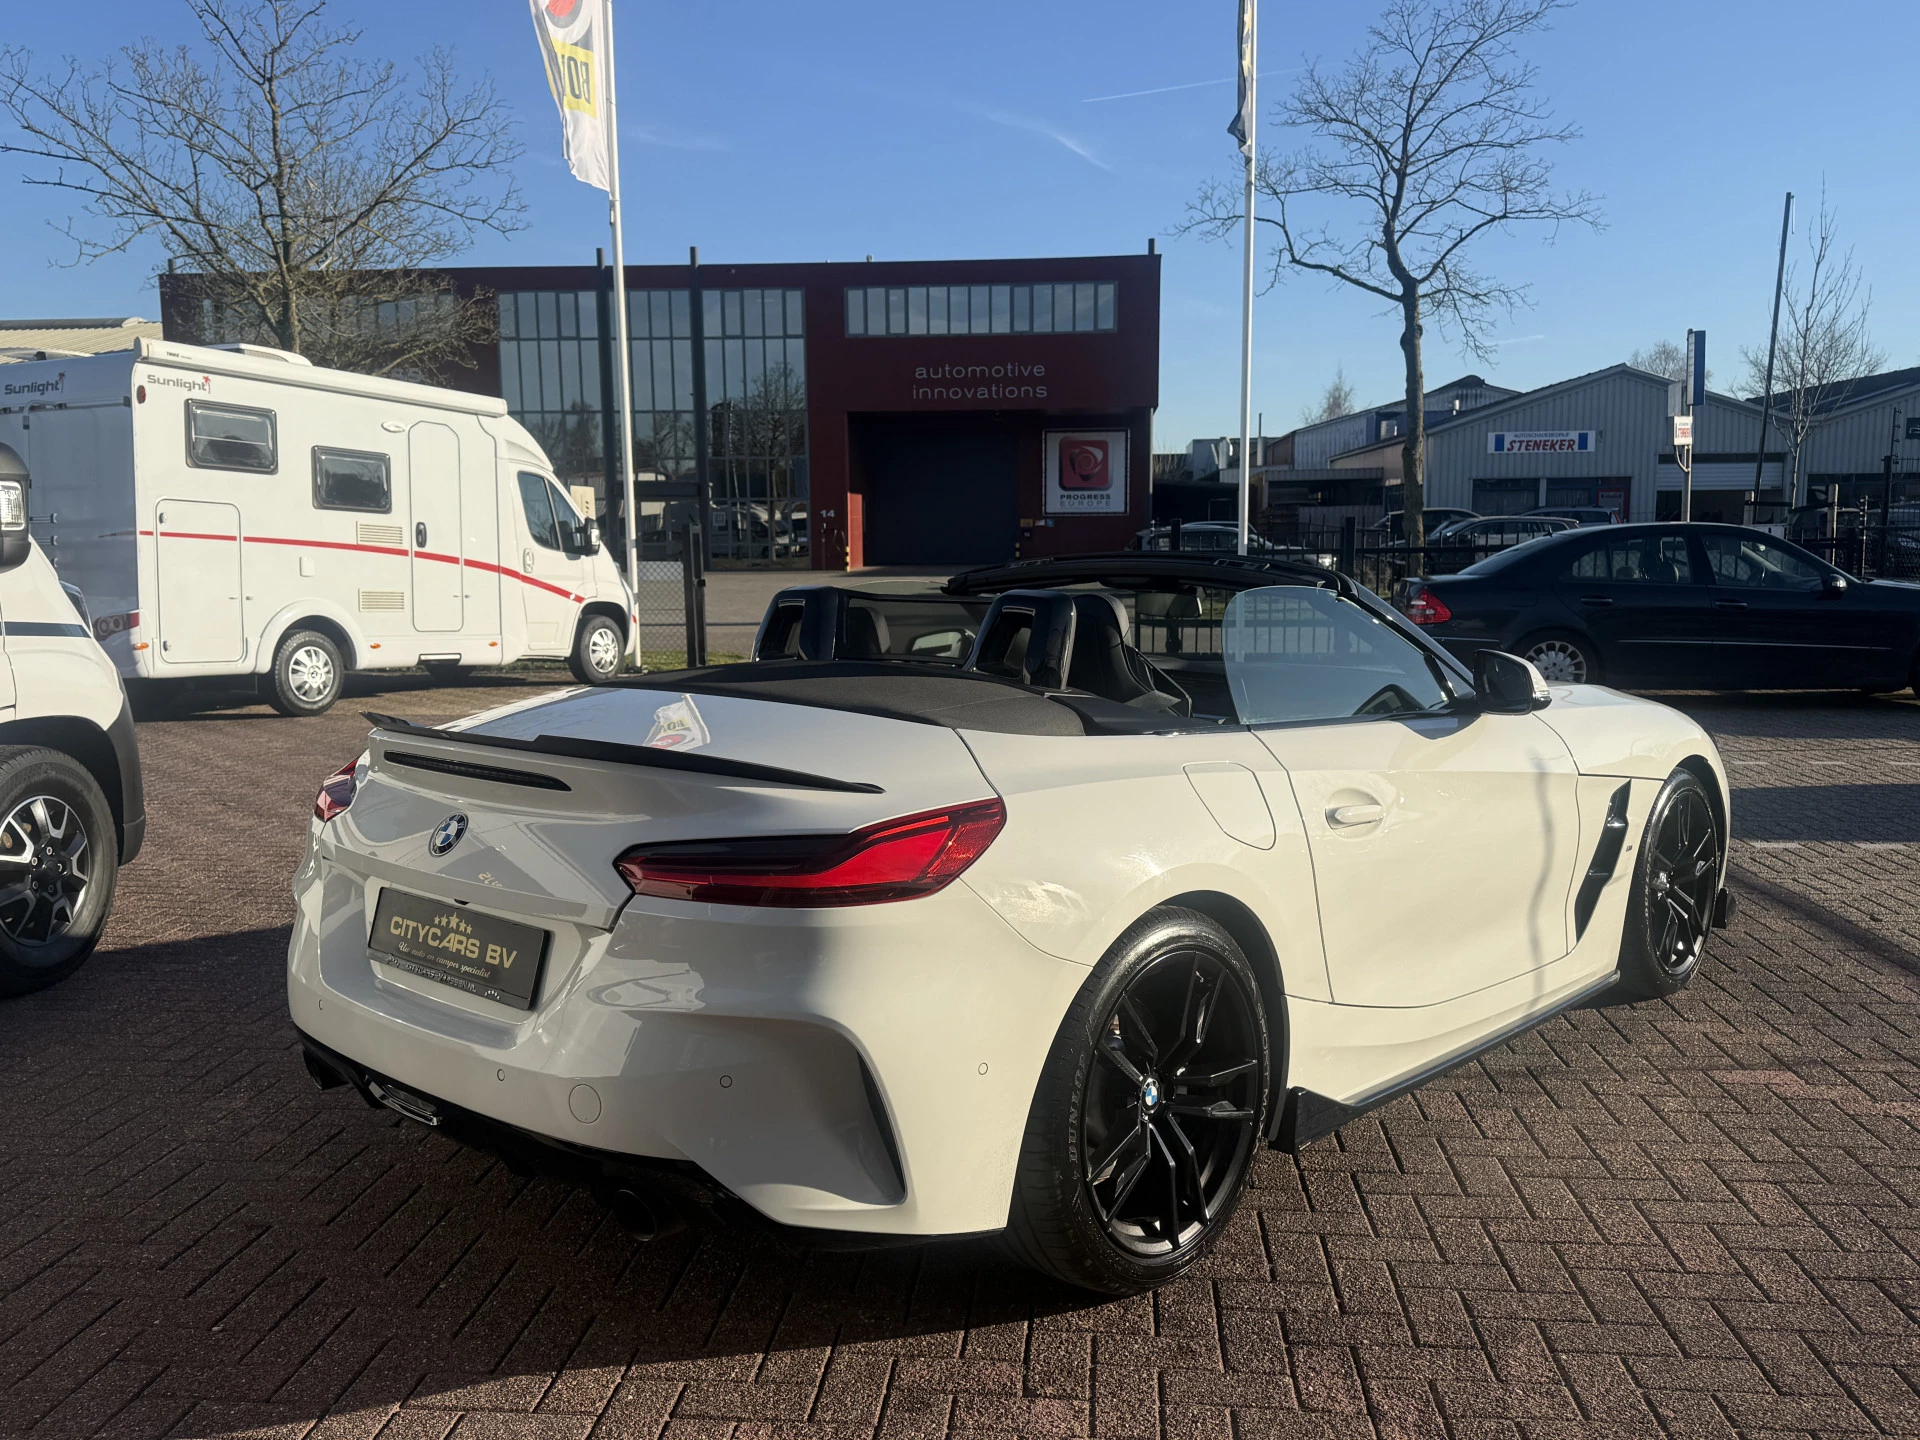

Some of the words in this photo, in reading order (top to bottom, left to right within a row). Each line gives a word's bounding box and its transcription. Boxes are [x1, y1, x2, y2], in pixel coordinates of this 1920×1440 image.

[915, 362, 1045, 379] automotive
[4, 379, 60, 396] Sunlight
[147, 374, 207, 391] Sunlight
[912, 383, 1048, 399] innovations
[1506, 439, 1576, 452] STENEKER
[820, 510, 835, 518] 14
[390, 916, 481, 959] CITYCARS
[485, 943, 517, 969] BV
[411, 948, 425, 958] auto
[436, 956, 460, 970] camper
[460, 964, 491, 979] specialist
[1069, 1051, 1086, 1163] DUNLOP
